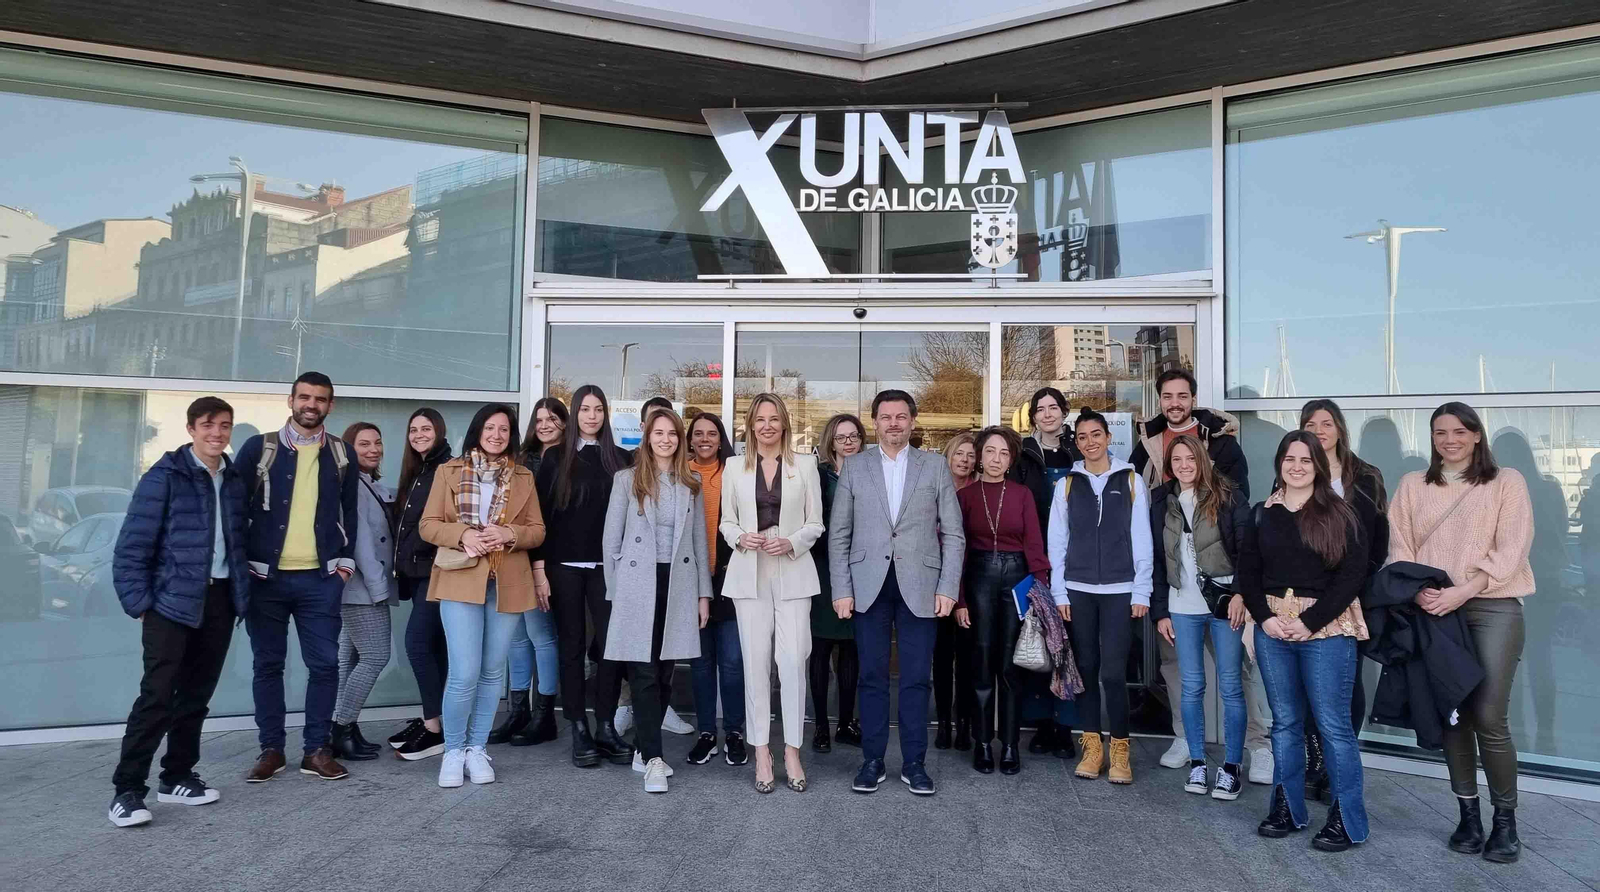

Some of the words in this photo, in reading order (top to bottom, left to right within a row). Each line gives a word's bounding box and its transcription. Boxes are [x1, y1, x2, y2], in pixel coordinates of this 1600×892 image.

[700, 108, 1027, 275] XUNTA
[800, 188, 838, 211] DE
[847, 187, 965, 211] GALICIA
